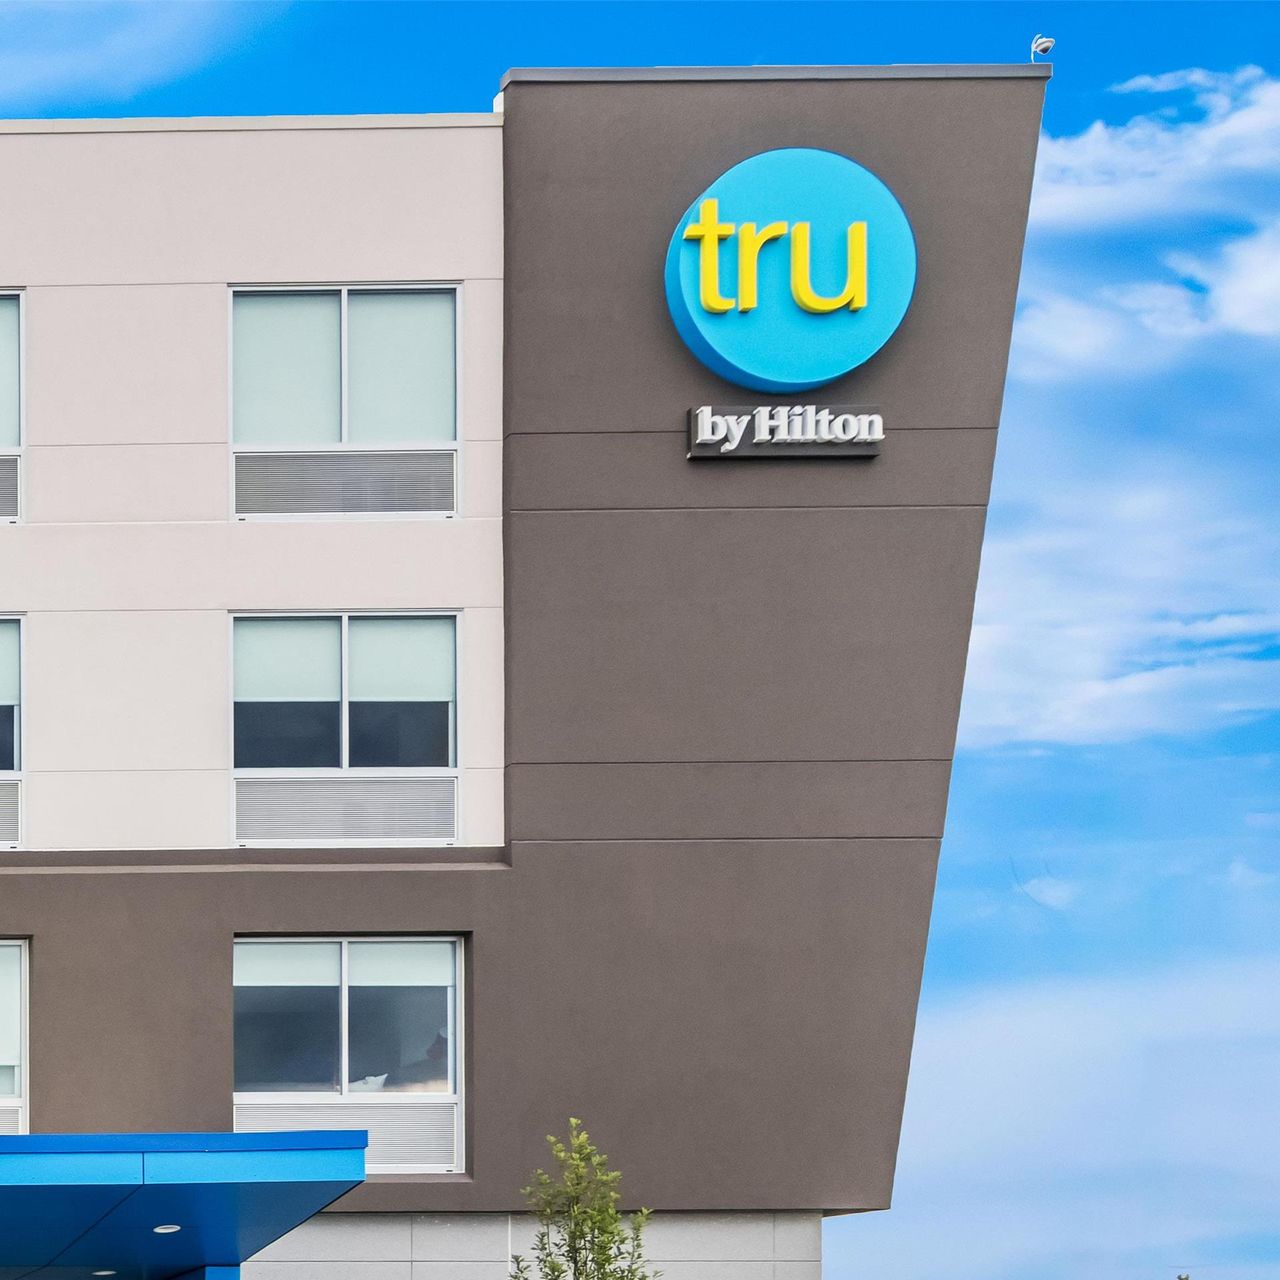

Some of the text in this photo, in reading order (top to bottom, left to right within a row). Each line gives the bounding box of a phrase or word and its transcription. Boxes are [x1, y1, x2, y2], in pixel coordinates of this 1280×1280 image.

[683, 198, 868, 314] tru
[695, 405, 885, 453] by Hilton
